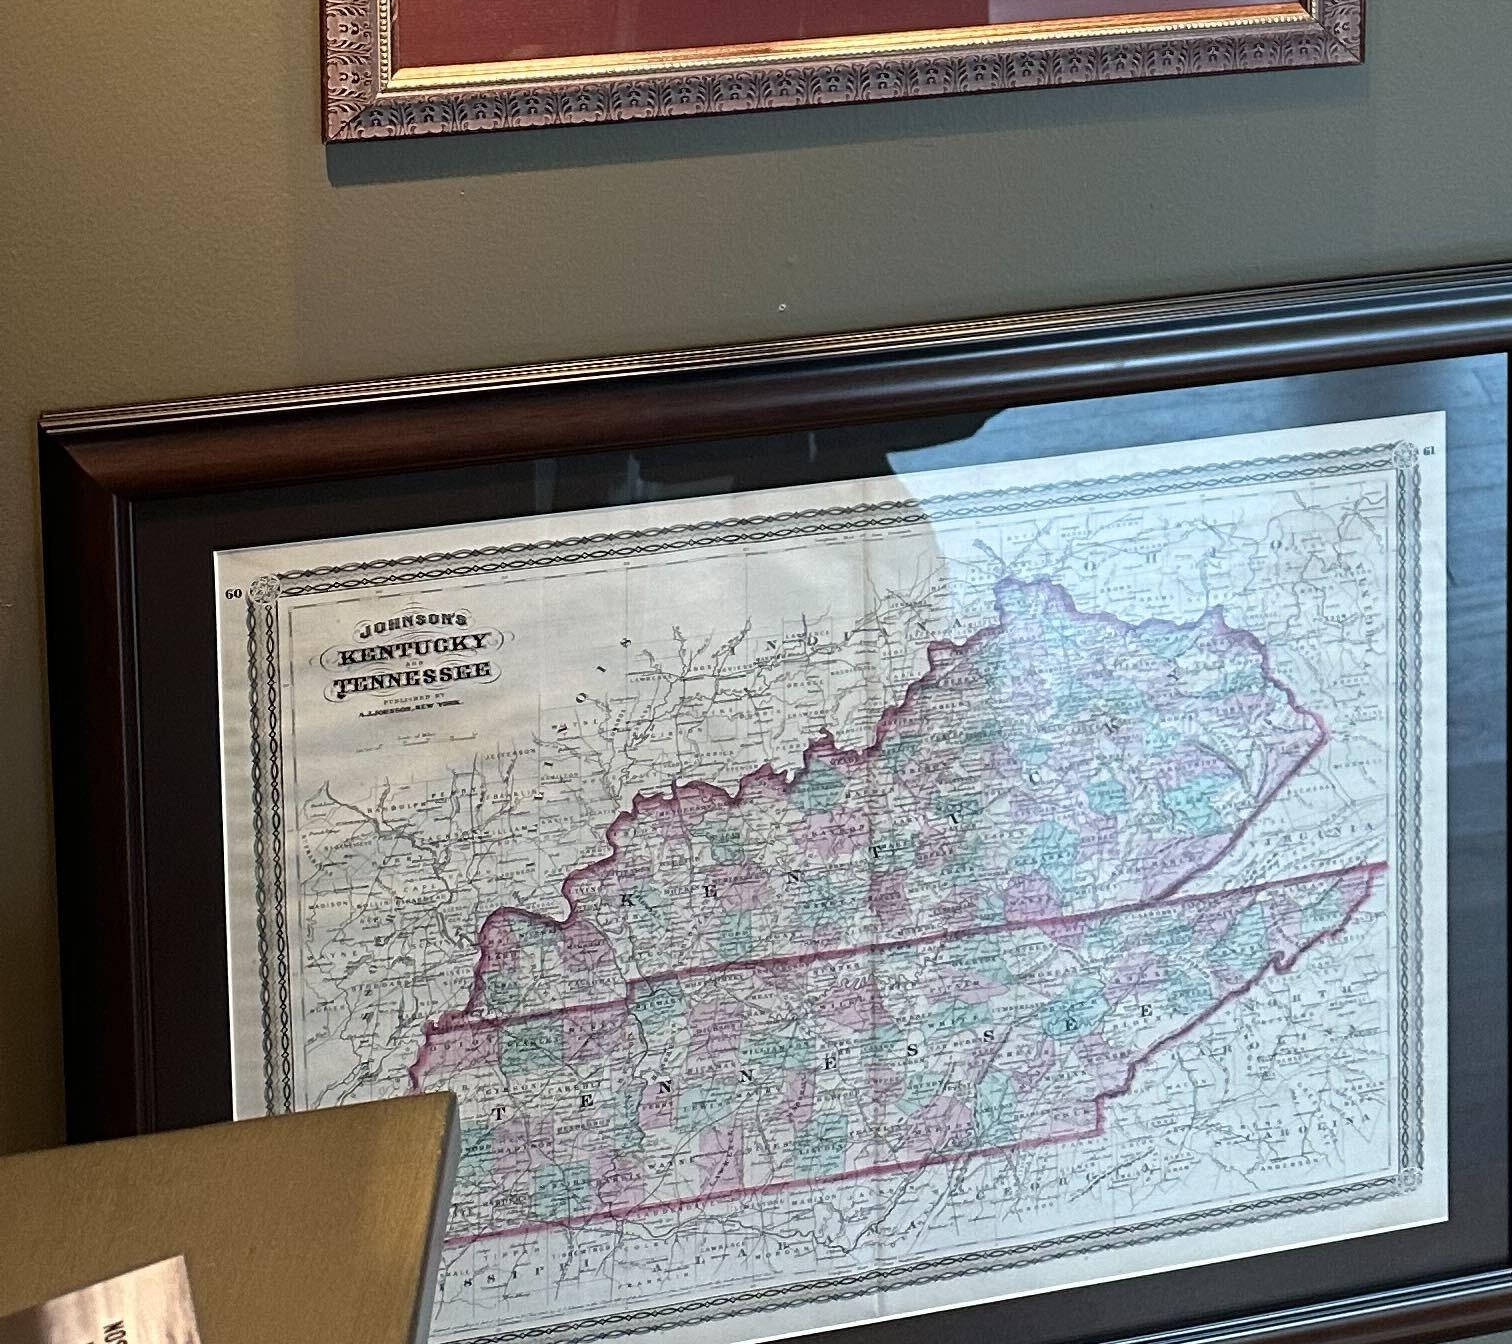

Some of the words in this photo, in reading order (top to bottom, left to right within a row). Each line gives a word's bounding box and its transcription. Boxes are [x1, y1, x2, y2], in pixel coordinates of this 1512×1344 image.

[225, 587, 242, 600] 60
[359, 613, 467, 640] JOHNSON'S
[336, 631, 493, 667] KENTUCKY
[333, 661, 492, 700] TENNESSEE
